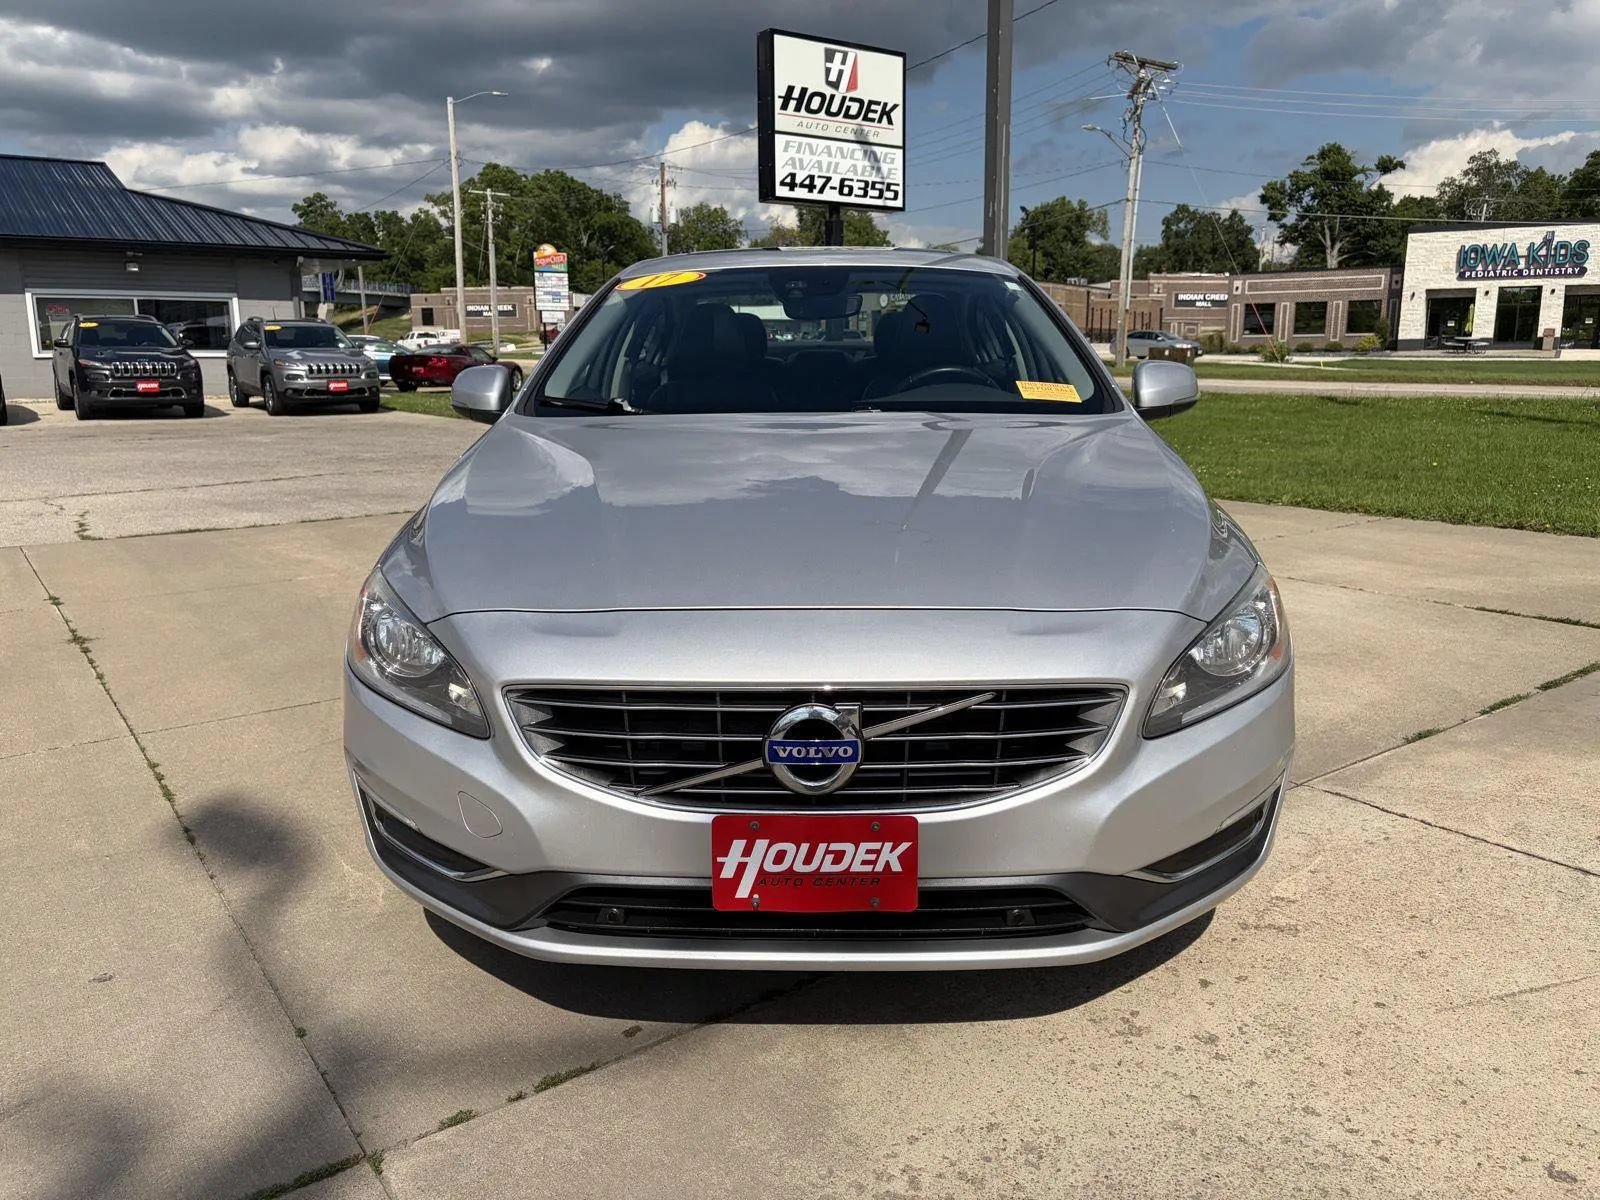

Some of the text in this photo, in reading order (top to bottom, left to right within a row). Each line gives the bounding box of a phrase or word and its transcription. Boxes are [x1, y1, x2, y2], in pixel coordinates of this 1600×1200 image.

[777, 84, 900, 126] HOUDEK
[796, 120, 880, 138] AUTO CENTER
[782, 139, 897, 165] FINANCING
[781, 156, 898, 180] AVAILABLE
[779, 172, 901, 201] 447-6355
[1458, 231, 1590, 269] IOWA KIDS
[1465, 267, 1580, 278] PEDIATRIC DENTISTRY
[773, 746, 853, 758] VOLVO
[716, 839, 913, 899] HOUDEK
[758, 877, 881, 887] AUTO CENTER
